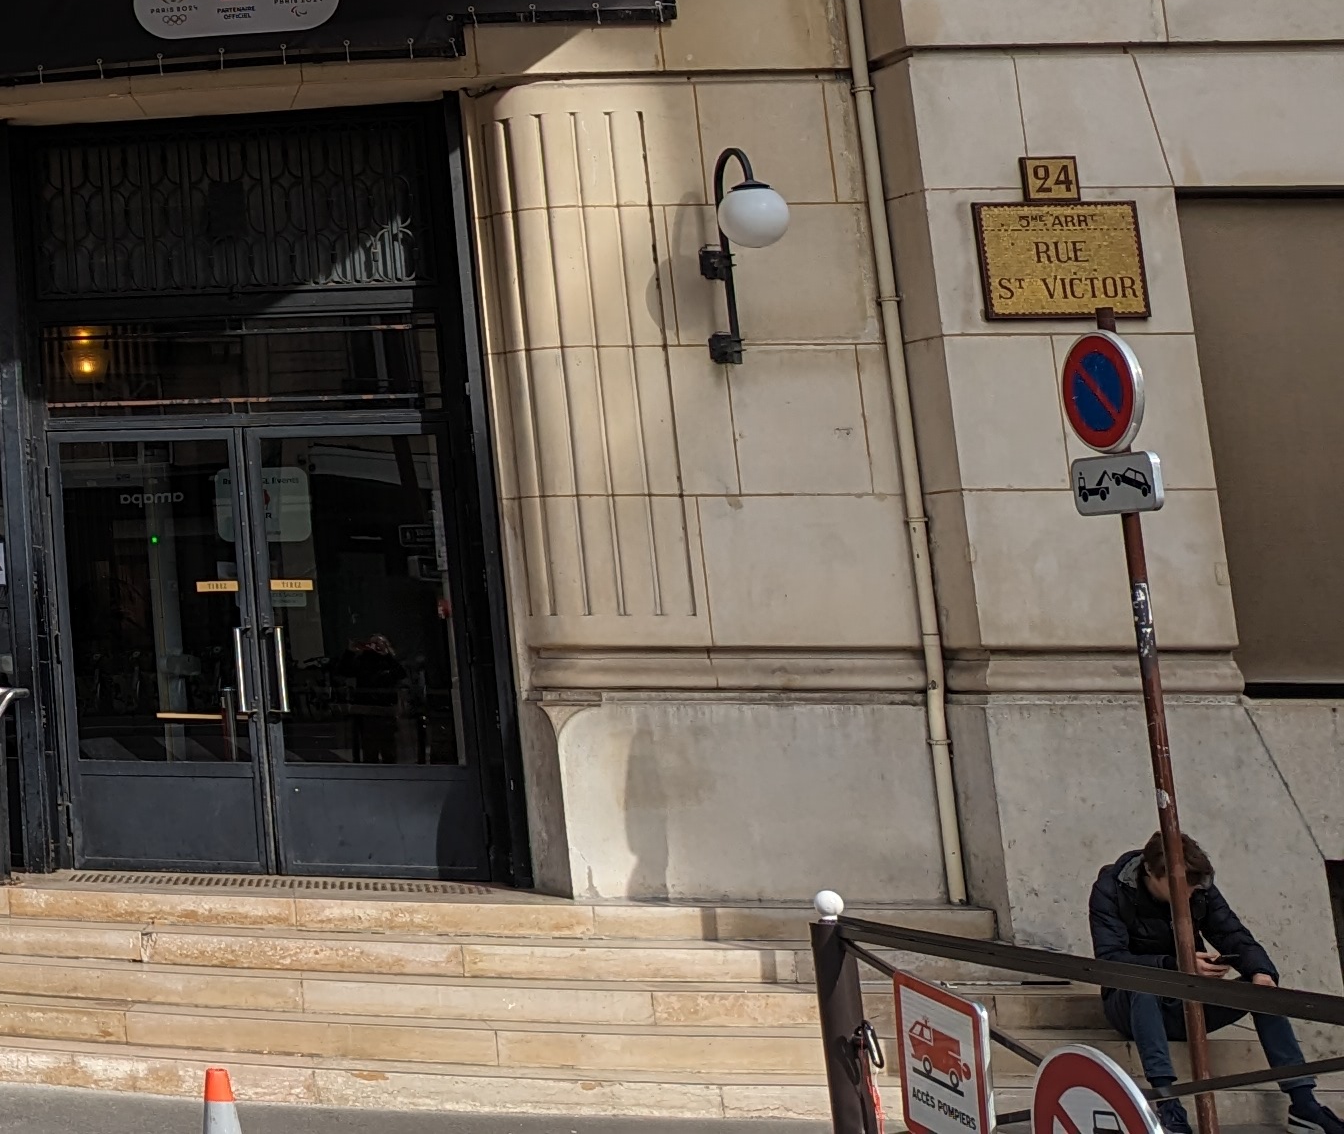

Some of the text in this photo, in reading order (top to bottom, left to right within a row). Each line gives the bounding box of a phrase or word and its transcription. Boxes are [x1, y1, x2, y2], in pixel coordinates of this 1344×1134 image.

[216, 5, 256, 14] PARTENAIRE
[223, 12, 252, 20] OFFICIEL
[1032, 164, 1074, 194] 24
[1033, 240, 1089, 264] RUE
[1041, 276, 1139, 300] VICTOR
[911, 1086, 977, 1130] ACCÈS POMPIERS
